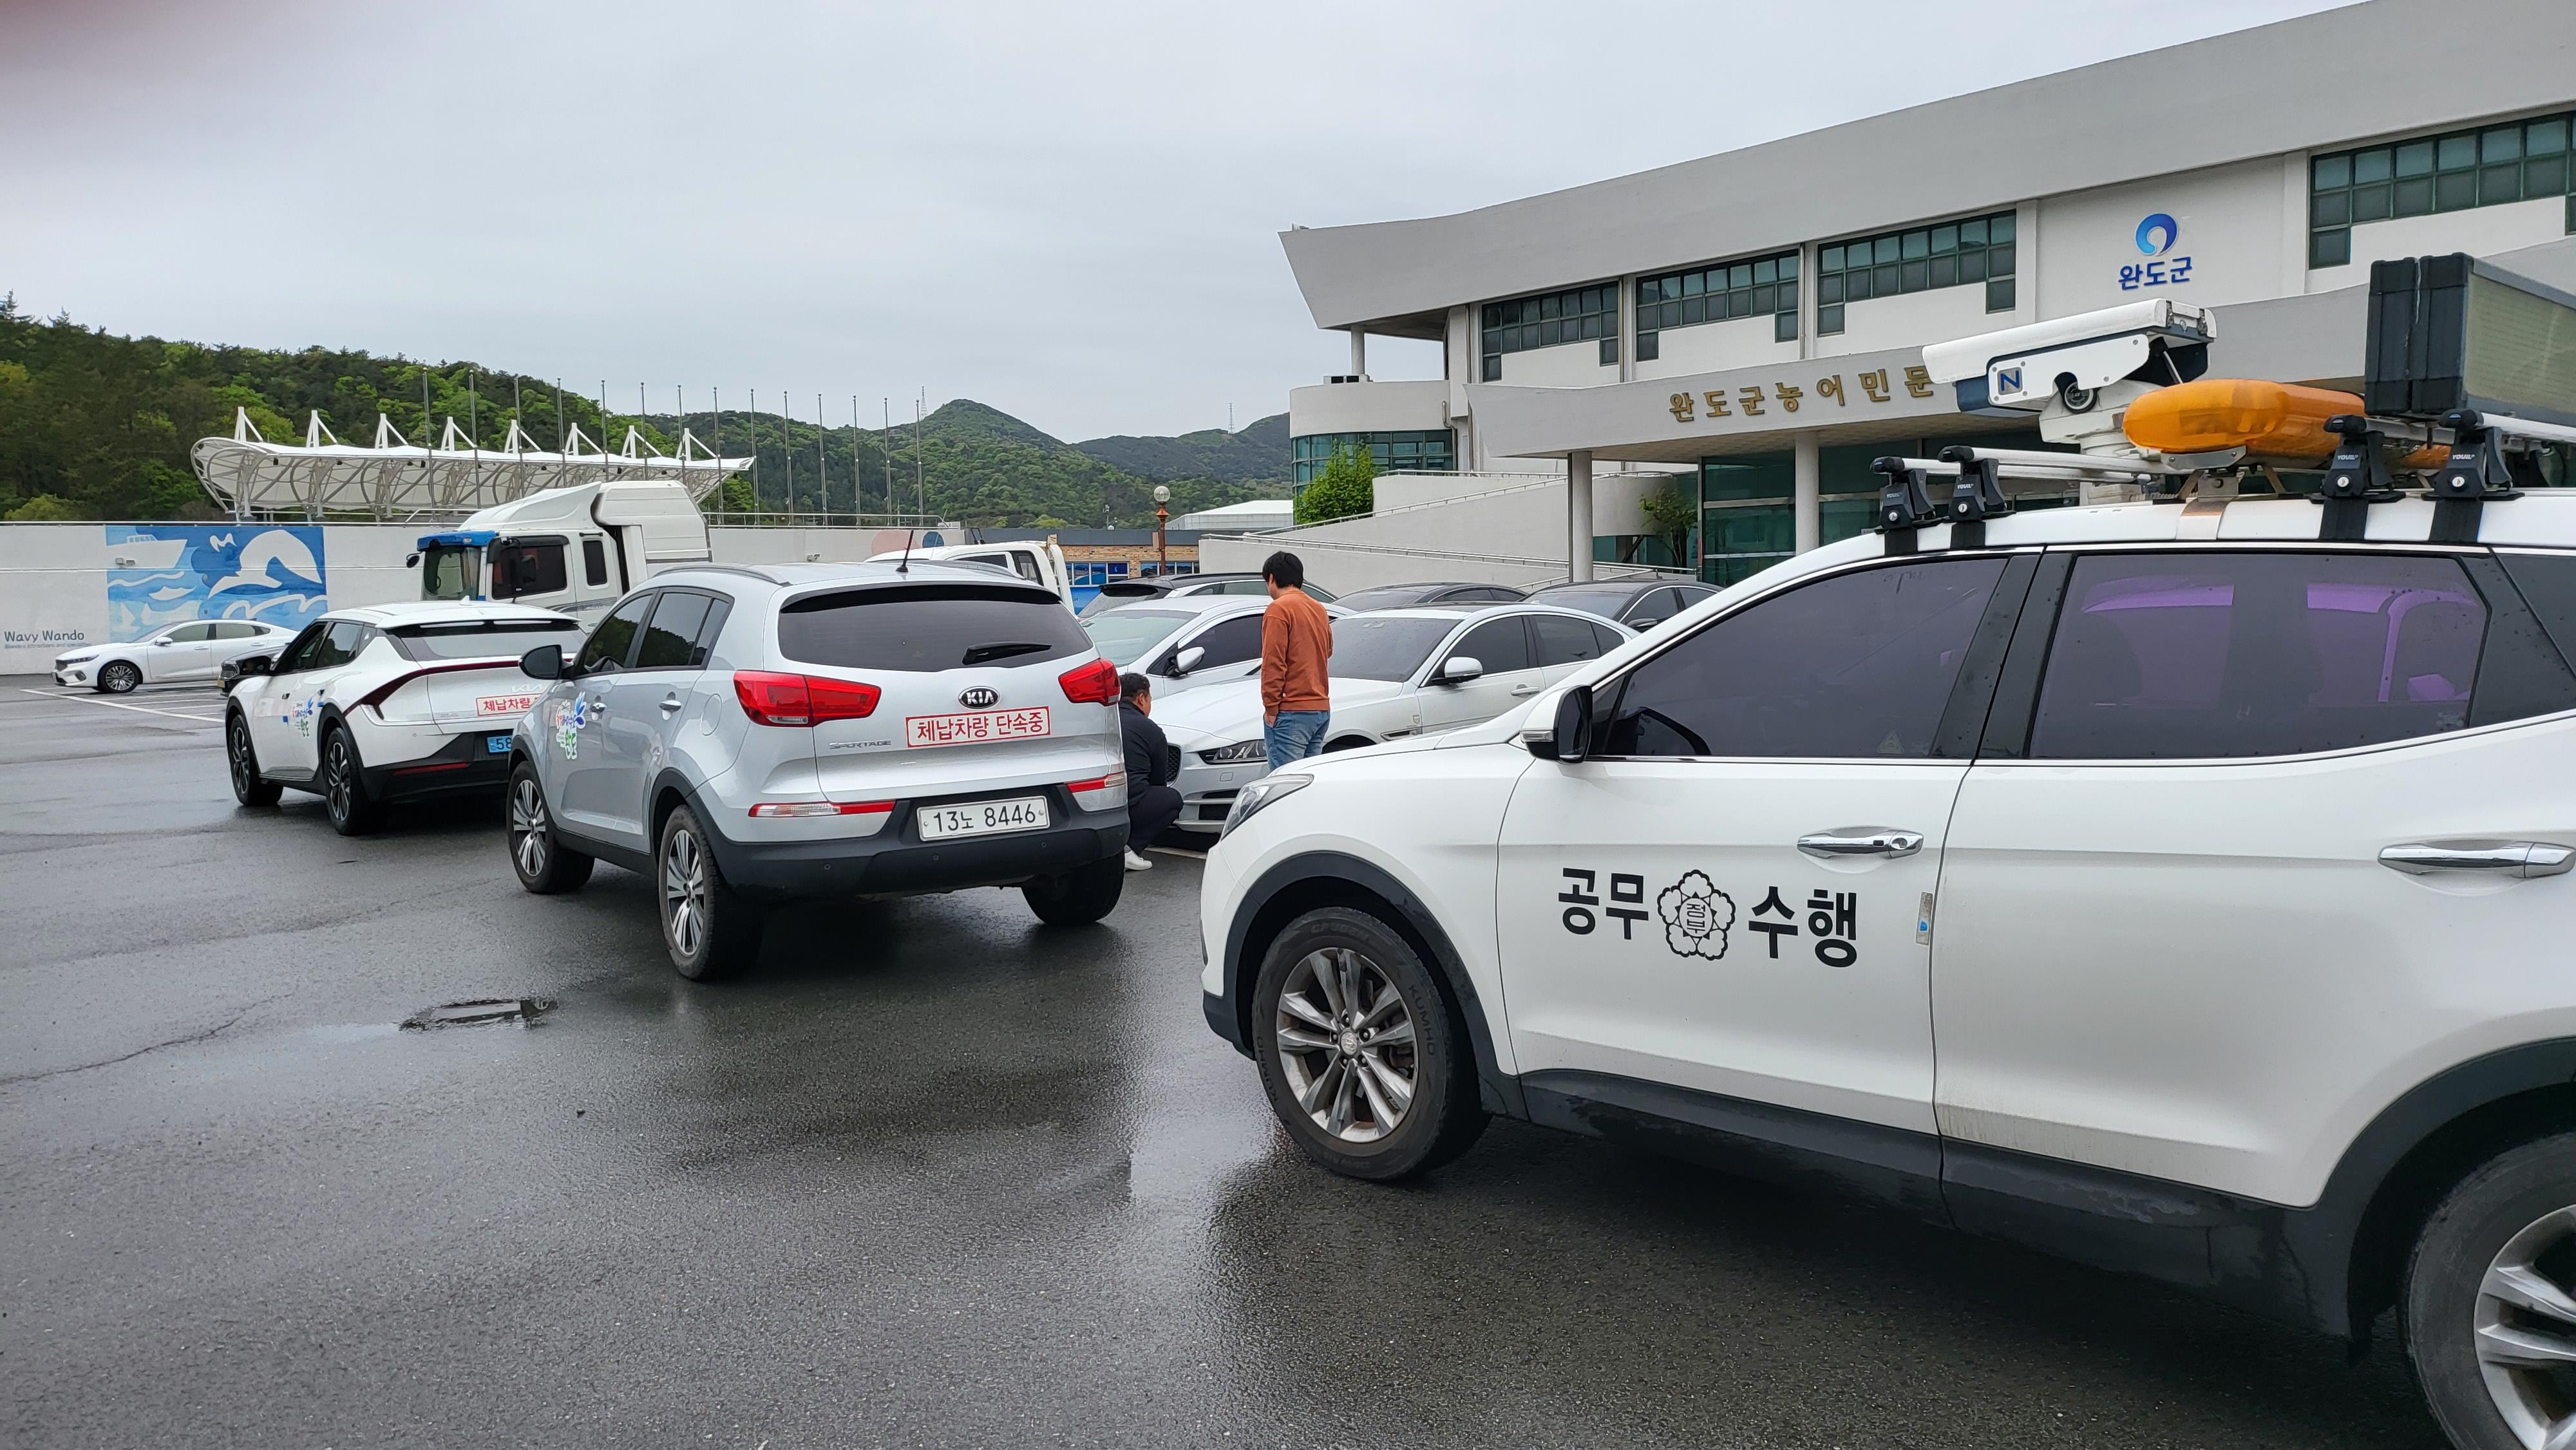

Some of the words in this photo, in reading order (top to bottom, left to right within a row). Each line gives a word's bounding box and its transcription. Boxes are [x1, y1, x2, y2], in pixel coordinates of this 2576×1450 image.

[2118, 256, 2192, 290] 완도군
[2000, 370, 2020, 391] N
[4, 631, 39, 643] Wavy
[42, 629, 84, 641] Wando
[484, 697, 531, 711] 체납차량
[966, 691, 995, 705] KIA
[917, 716, 989, 741] 체납차량
[996, 712, 1043, 735] 단속중
[934, 811, 974, 833] 13노
[984, 804, 1036, 827] 8446
[1558, 867, 1649, 940] 공무
[1748, 886, 1858, 968] 수행
[1687, 903, 1706, 934] 정부
